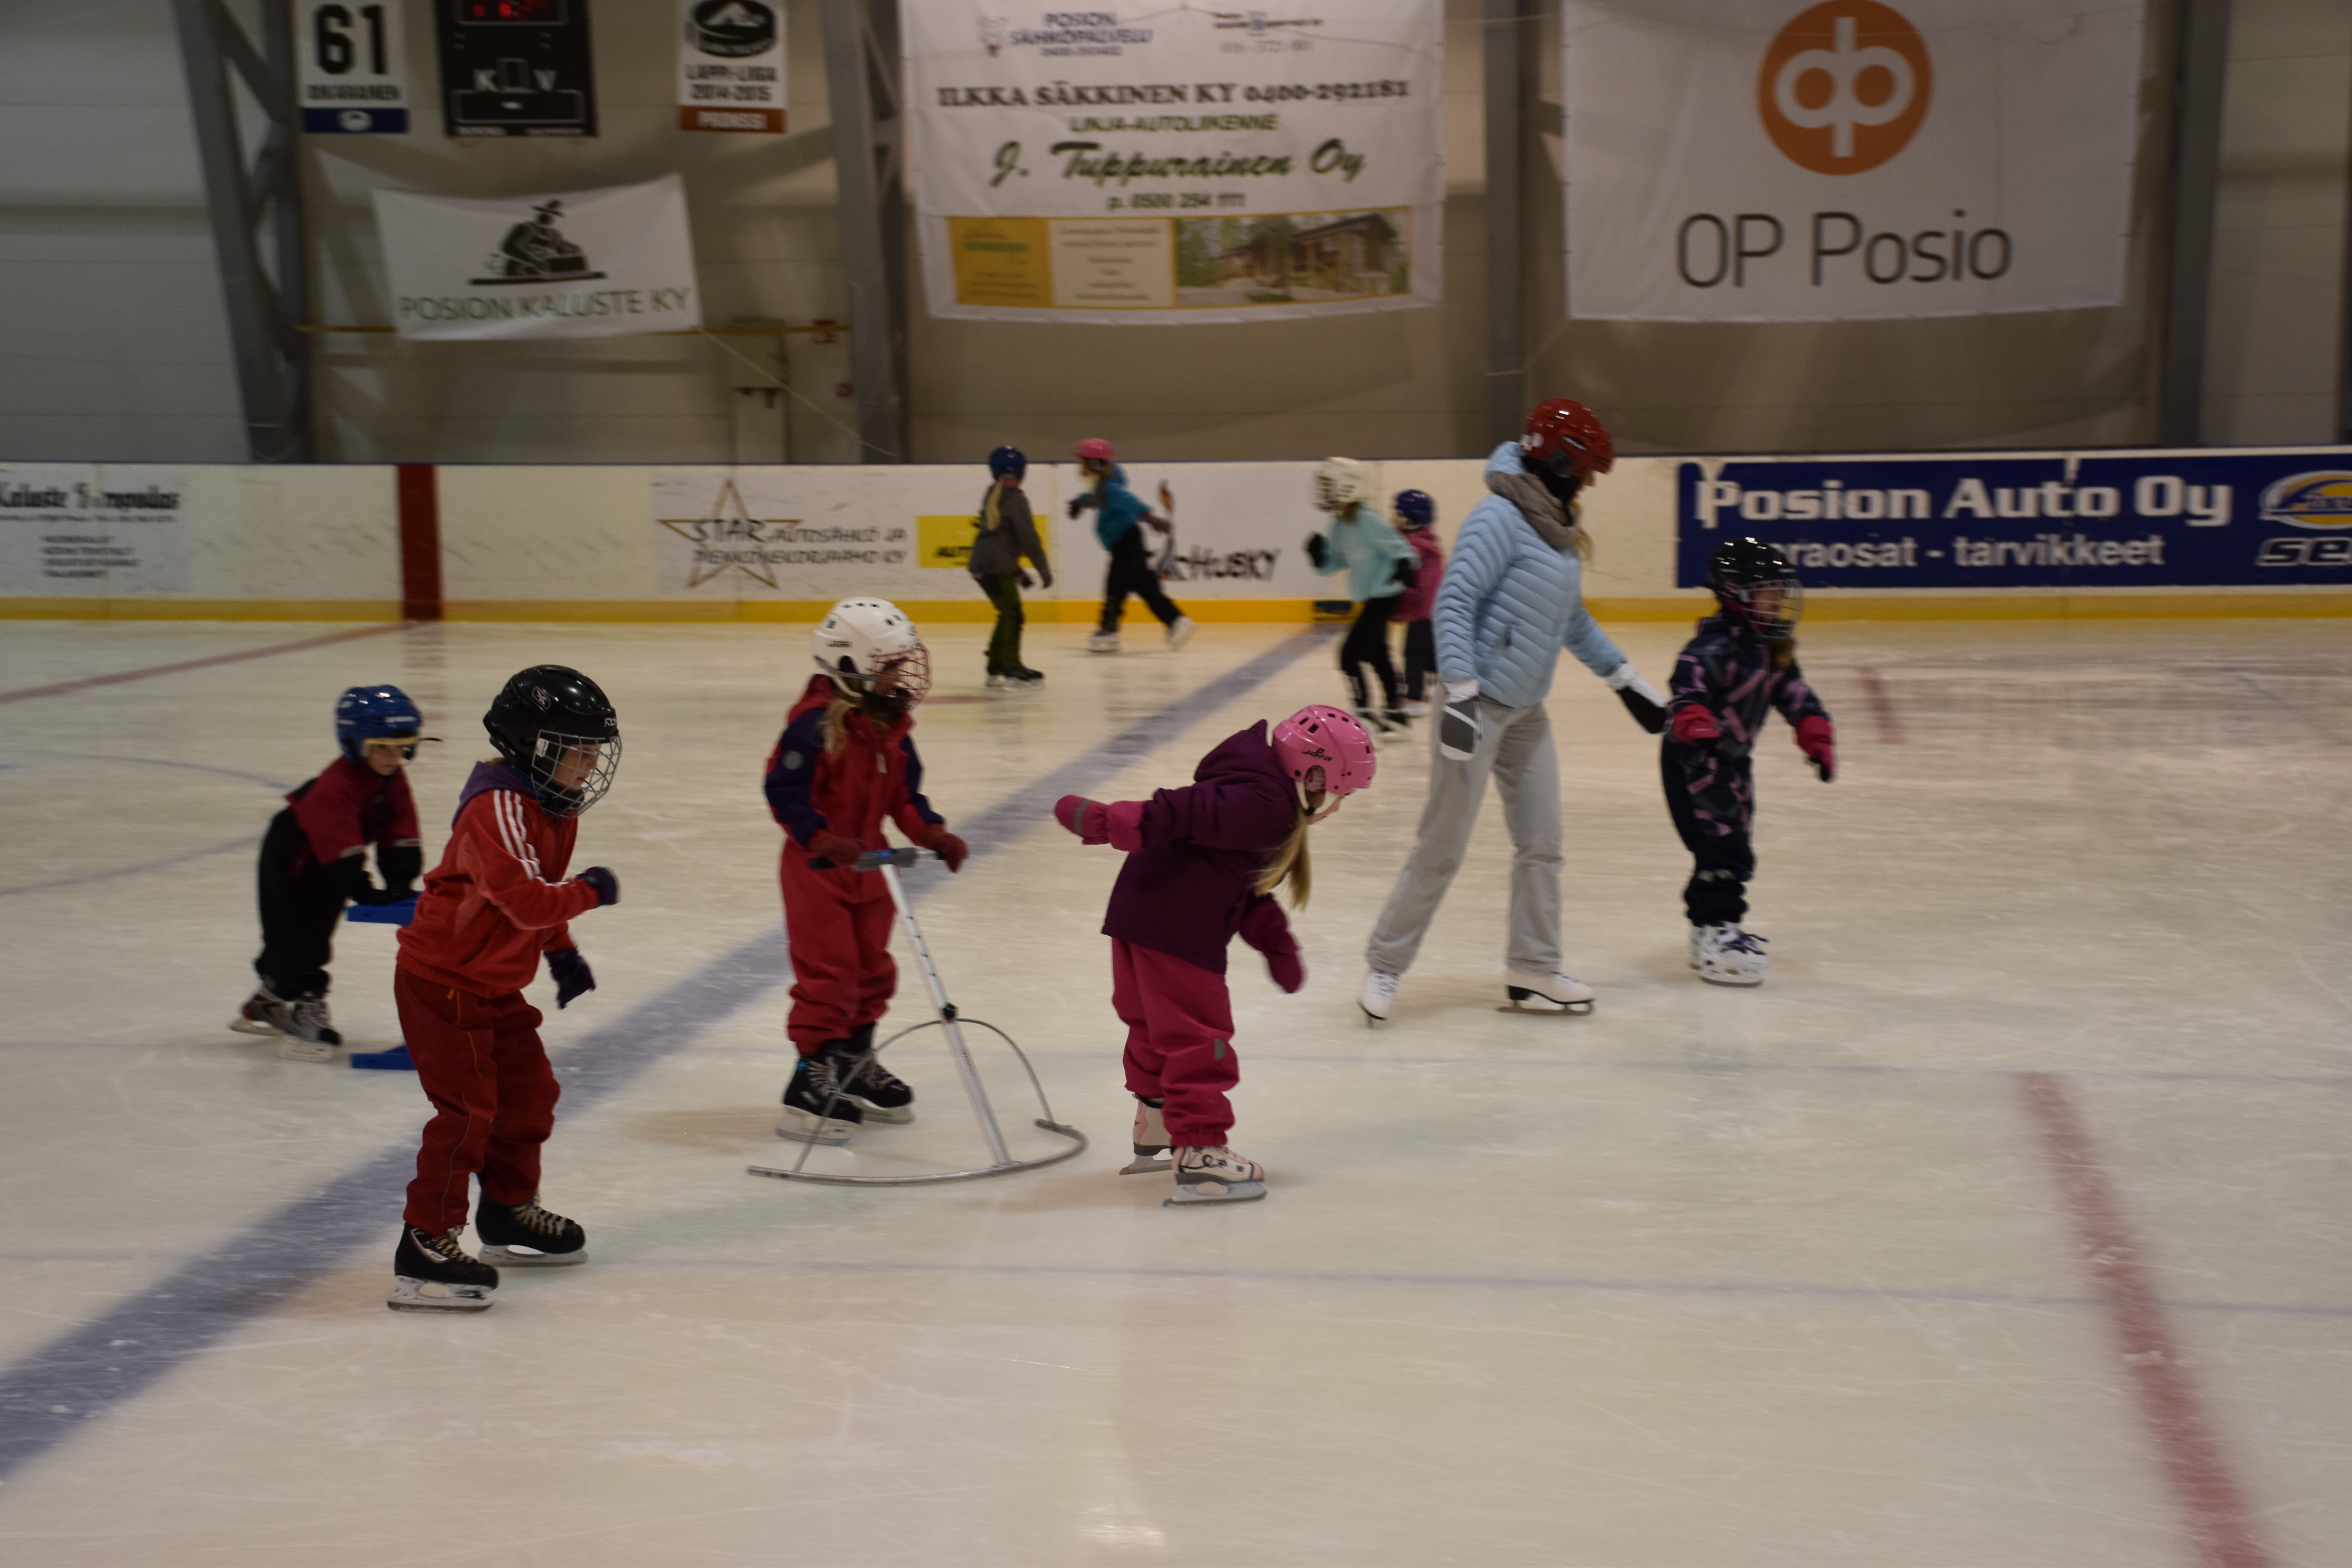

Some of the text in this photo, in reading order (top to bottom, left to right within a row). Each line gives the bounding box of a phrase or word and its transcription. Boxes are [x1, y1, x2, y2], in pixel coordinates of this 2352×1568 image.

[1044, 13, 1117, 27] POSION
[316, 3, 388, 74] 61
[691, 83, 770, 101] 2014-2015
[938, 80, 1410, 106] ILKKA SÄKKINEN KY 0400-292181
[1049, 141, 1295, 187] Tuppurainen
[1308, 138, 1366, 183] Oy
[1676, 209, 2014, 289] OP Posio
[398, 286, 692, 321] POSION KALUSTE KY
[1693, 475, 2234, 527] Posion Auto Oy
[692, 519, 766, 543] STAR
[1952, 533, 2167, 567] tarvikkeet
